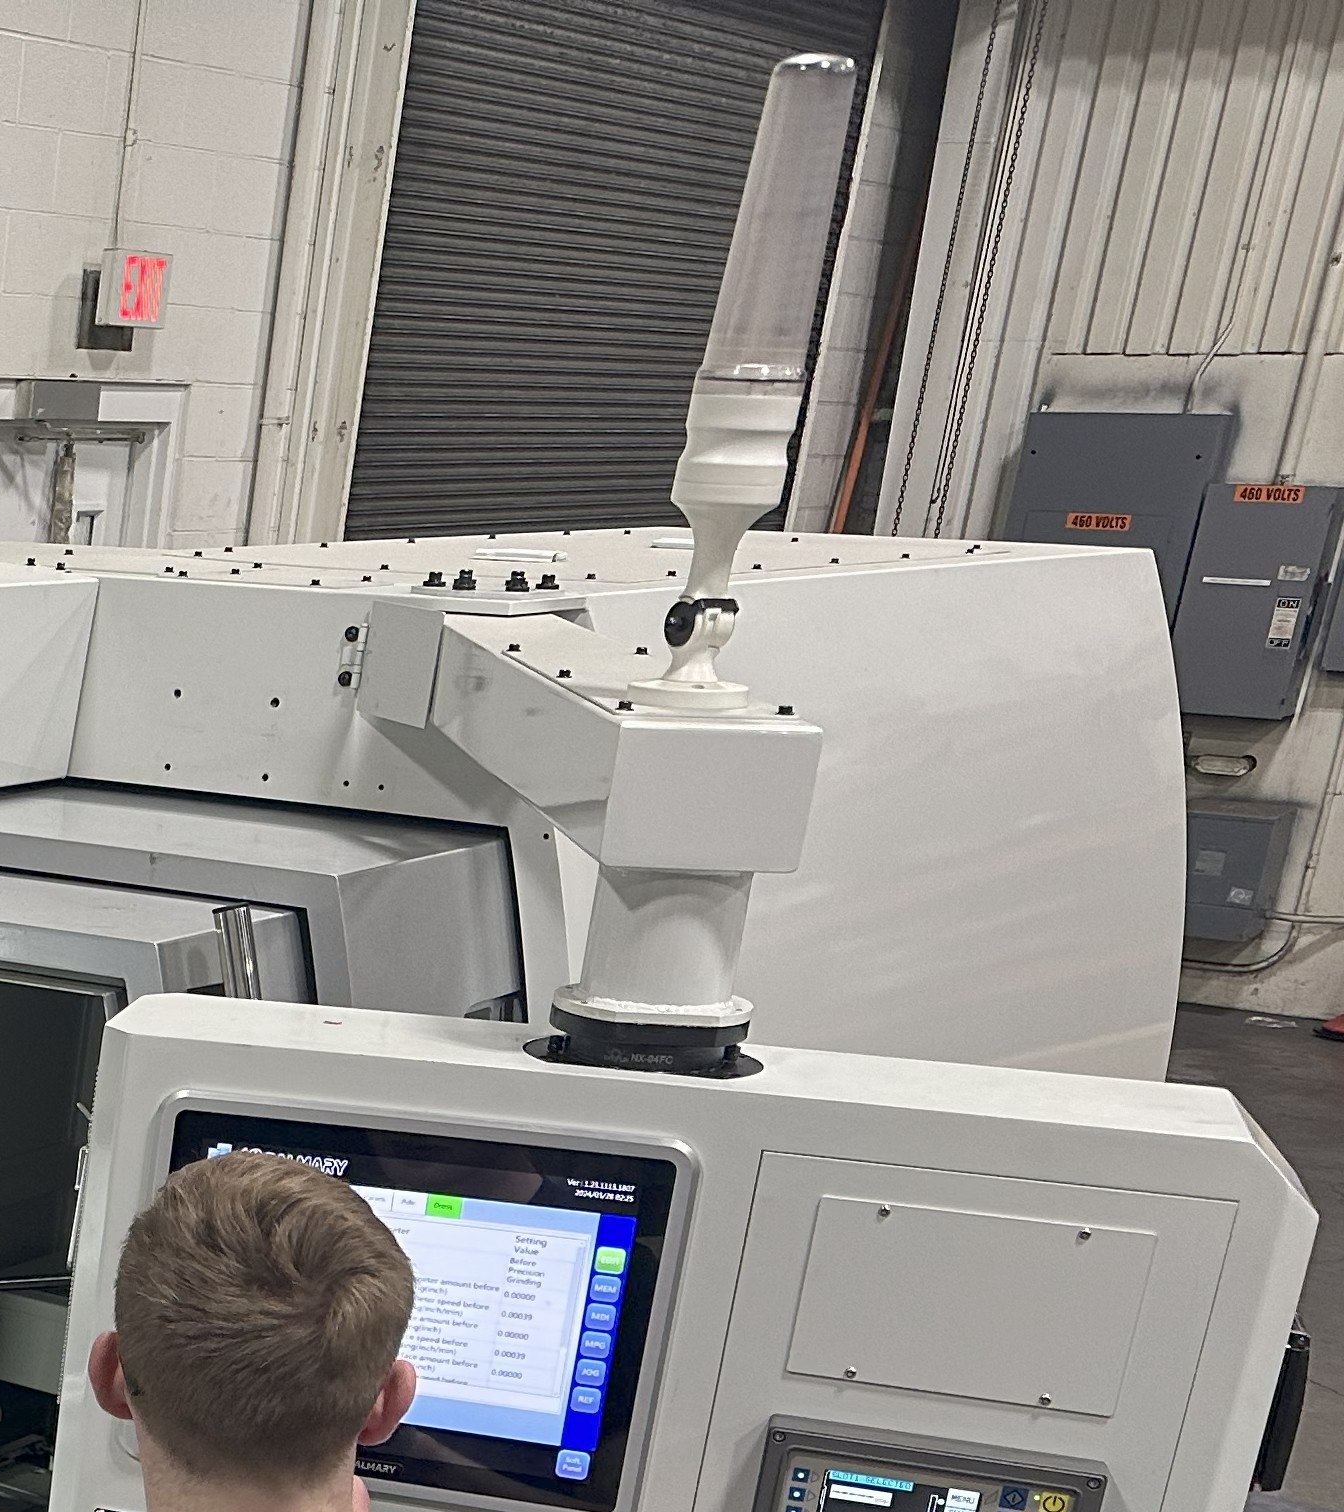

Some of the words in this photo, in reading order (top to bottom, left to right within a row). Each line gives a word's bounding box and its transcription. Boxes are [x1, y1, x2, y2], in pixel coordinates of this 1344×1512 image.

[119, 255, 166, 322] EXIT
[1240, 487, 1262, 501] 460
[1266, 488, 1300, 502] VOLTS
[1071, 514, 1092, 528] 460
[1095, 516, 1127, 530] VOLTS
[1279, 600, 1298, 608] ON
[1268, 639, 1289, 648] OFF
[515, 1235, 548, 1248] Setting
[514, 1246, 539, 1256] Value
[509, 1257, 537, 1267] Before
[508, 1267, 545, 1278] Precision
[440, 1279, 472, 1289] amount
[473, 1283, 500, 1292] before
[506, 1277, 542, 1288] Grinding
[594, 1284, 617, 1293] MEM
[437, 1299, 461, 1307] speed
[463, 1301, 490, 1311] before
[420, 1316, 450, 1325] amount
[452, 1320, 479, 1329] before
[591, 1313, 610, 1322] MDI
[416, 1335, 440, 1344] speed
[442, 1338, 469, 1348] before
[585, 1340, 606, 1350] MPG
[419, 1355, 450, 1365] amount
[452, 1359, 479, 1369] before
[581, 1368, 600, 1378] JOG
[578, 1395, 595, 1405] REF
[950, 1494, 975, 1505] MENU
